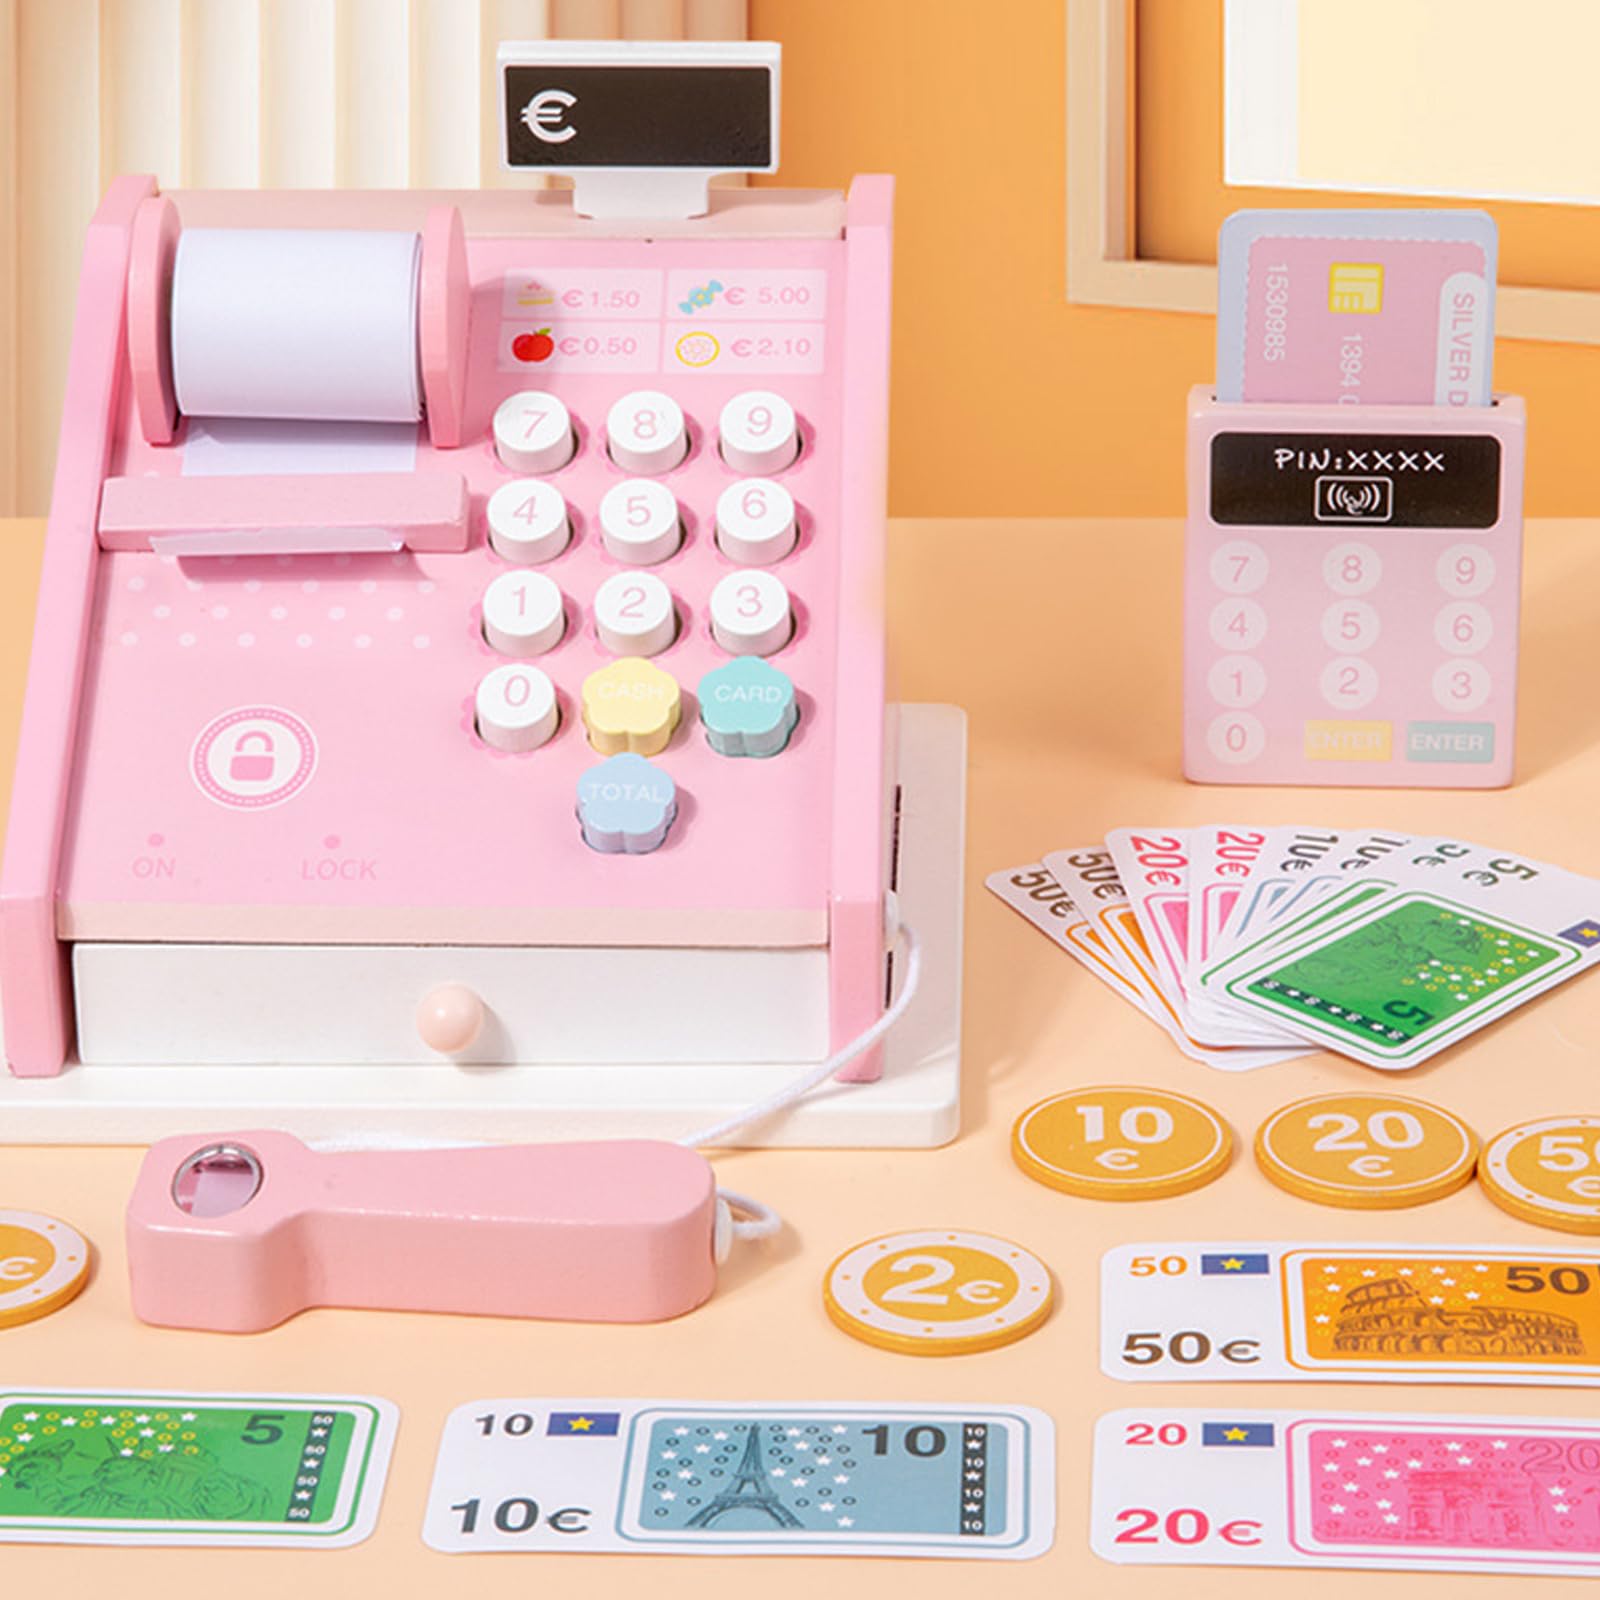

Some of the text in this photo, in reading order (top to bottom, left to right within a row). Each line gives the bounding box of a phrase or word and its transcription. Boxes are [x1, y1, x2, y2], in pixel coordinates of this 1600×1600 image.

[520, 89, 578, 143] €
[1264, 263, 1288, 361] 1530985
[1449, 292, 1475, 382] SILVER
[1340, 332, 1363, 388] 1394
[523, 405, 774, 440] 7 8 9
[512, 488, 767, 527] 4 5 6
[1228, 554, 1477, 586] 7 8 9
[512, 585, 763, 618] 1 2 3
[1227, 612, 1474, 643] 4 5 6
[503, 675, 783, 708] 0 CASH CARD
[1230, 667, 1472, 700] 1 2 3
[1225, 724, 1247, 753] 0
[1410, 732, 1485, 752] ENTER
[588, 783, 664, 803] TOTAL
[131, 855, 177, 880] ON
[301, 857, 378, 881] LOCK
[1130, 835, 1189, 886] 20€
[1462, 858, 1539, 887] 5€
[1381, 1000, 1436, 1026] 5
[1076, 1105, 1174, 1144] 10
[1306, 1109, 1425, 1152] 20
[1094, 1148, 1139, 1171] €
[1348, 1154, 1394, 1178] €
[1537, 1135, 1600, 1172] 5
[1129, 1255, 1188, 1277] 50
[1506, 1265, 1590, 1296] 50
[1122, 1331, 1261, 1365] 50€
[240, 1414, 286, 1446] 5
[474, 1412, 535, 1436] 10
[966, 1427, 985, 1437] 10
[1124, 1422, 1188, 1446] 20
[861, 1423, 948, 1458] 10
[965, 1457, 984, 1469] 10
[964, 1488, 984, 1499] 10
[451, 1496, 592, 1534] 10€
[962, 1520, 983, 1531] 10
[1114, 1508, 1263, 1546] 20€
